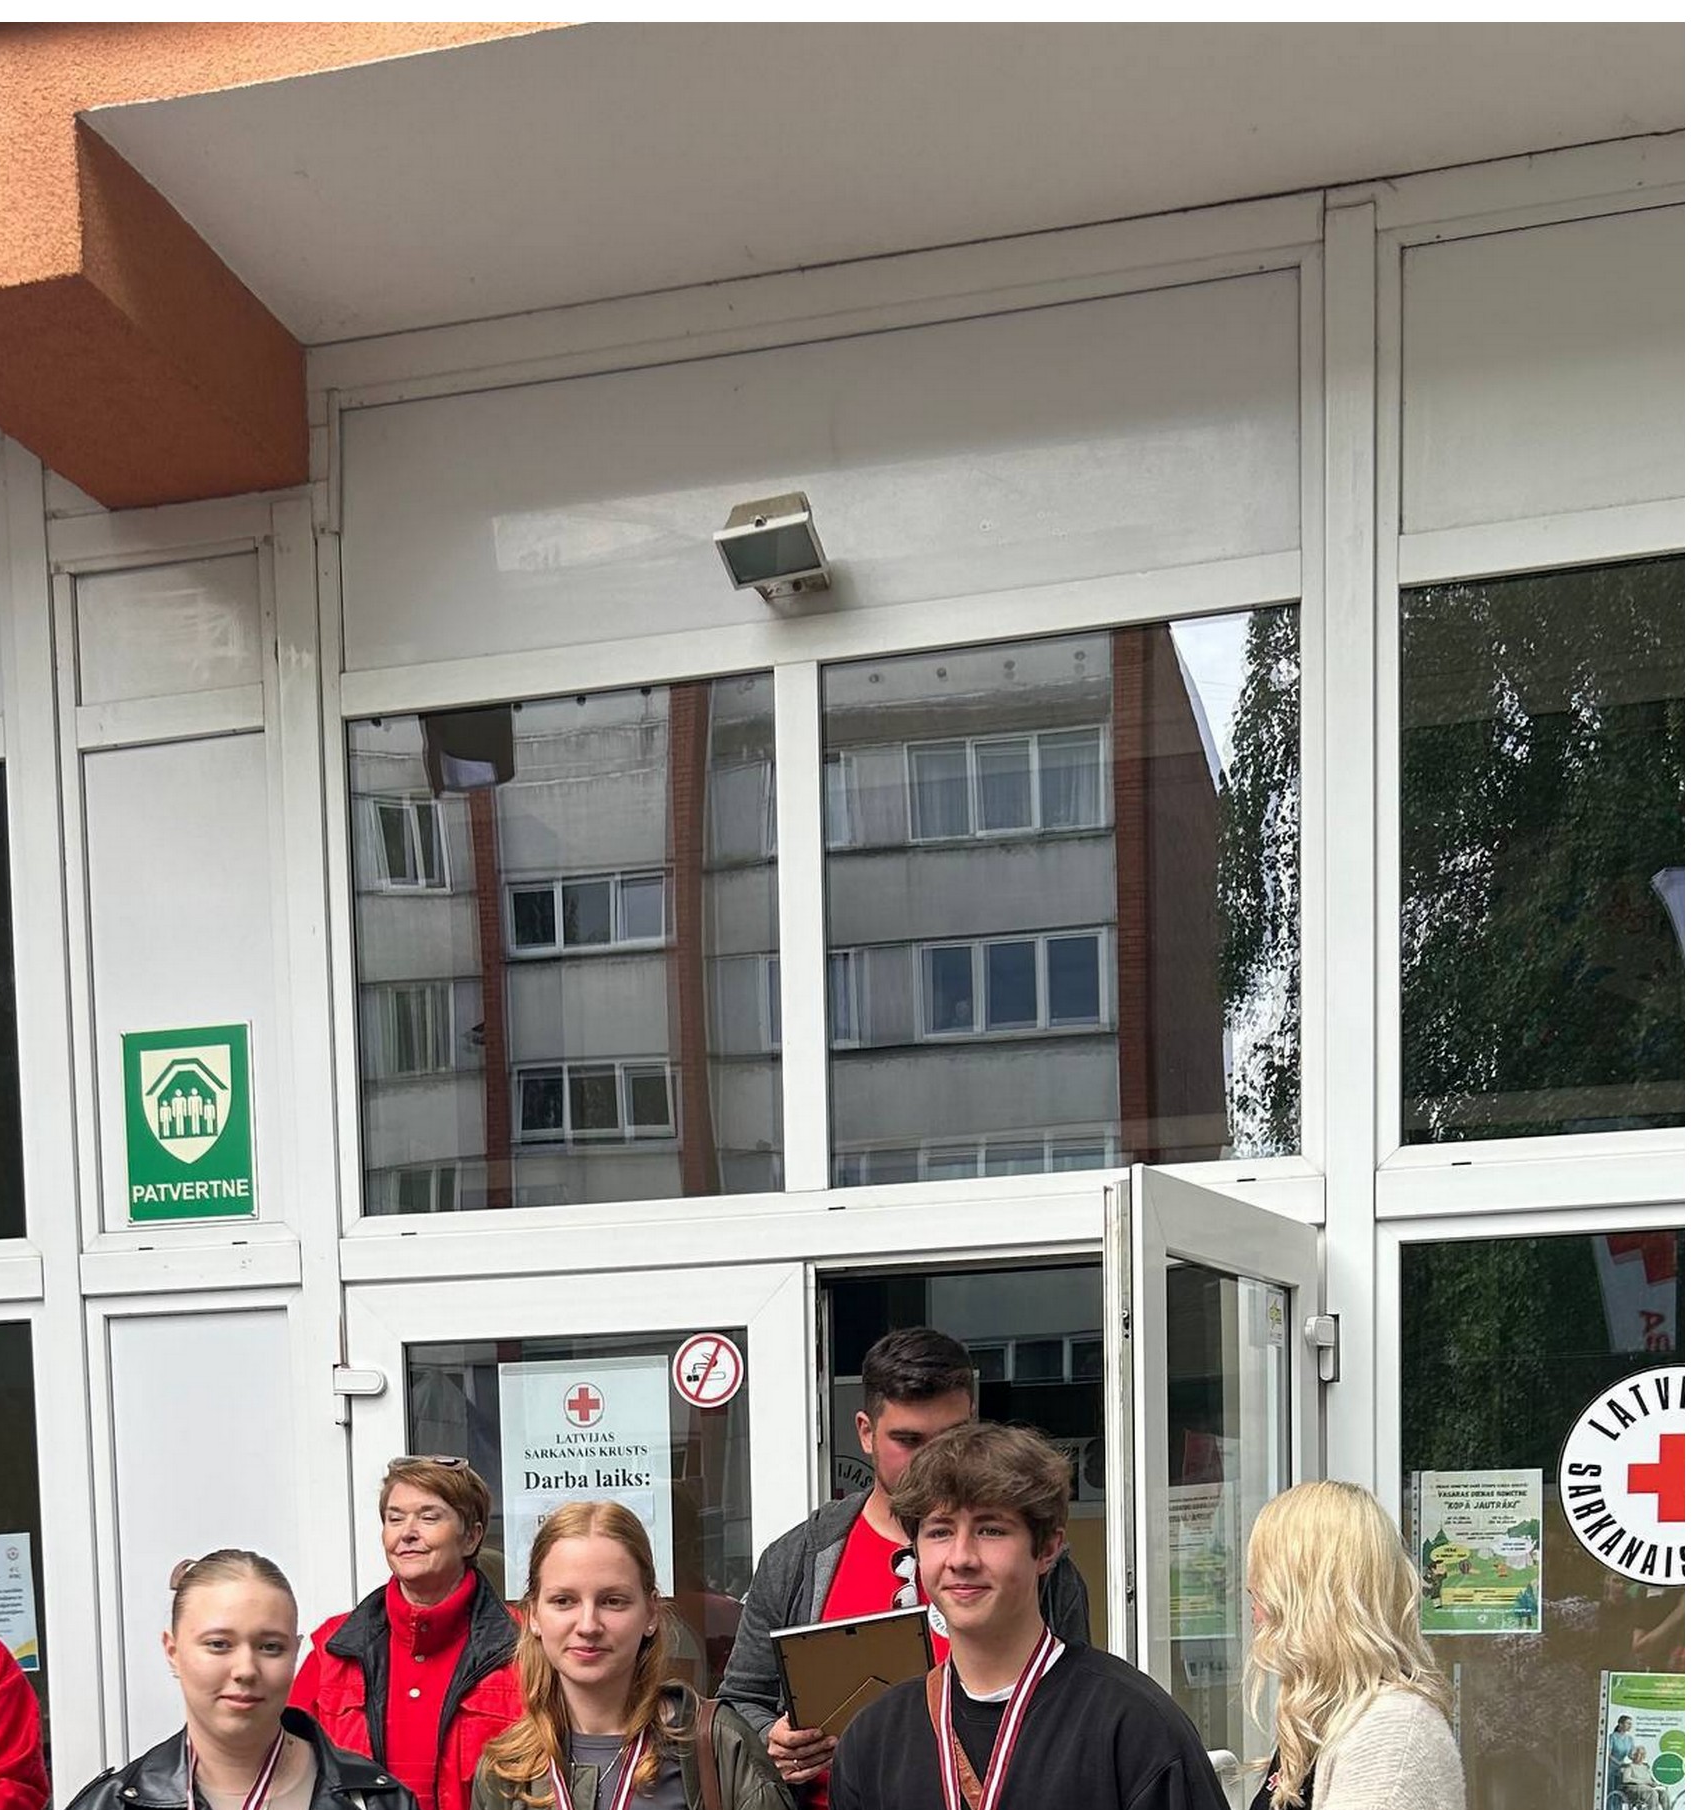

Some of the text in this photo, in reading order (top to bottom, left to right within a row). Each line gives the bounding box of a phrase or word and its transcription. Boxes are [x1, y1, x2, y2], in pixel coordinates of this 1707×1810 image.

[132, 1178, 250, 1204] PATVERTNE
[1587, 1375, 1686, 1441] LATVI
[556, 1432, 615, 1444] LATVIJAS
[524, 1445, 648, 1460] SARKANAIS KRUSTS
[524, 1468, 651, 1490] Darba laiks:
[838, 1463, 873, 1489] IJAS
